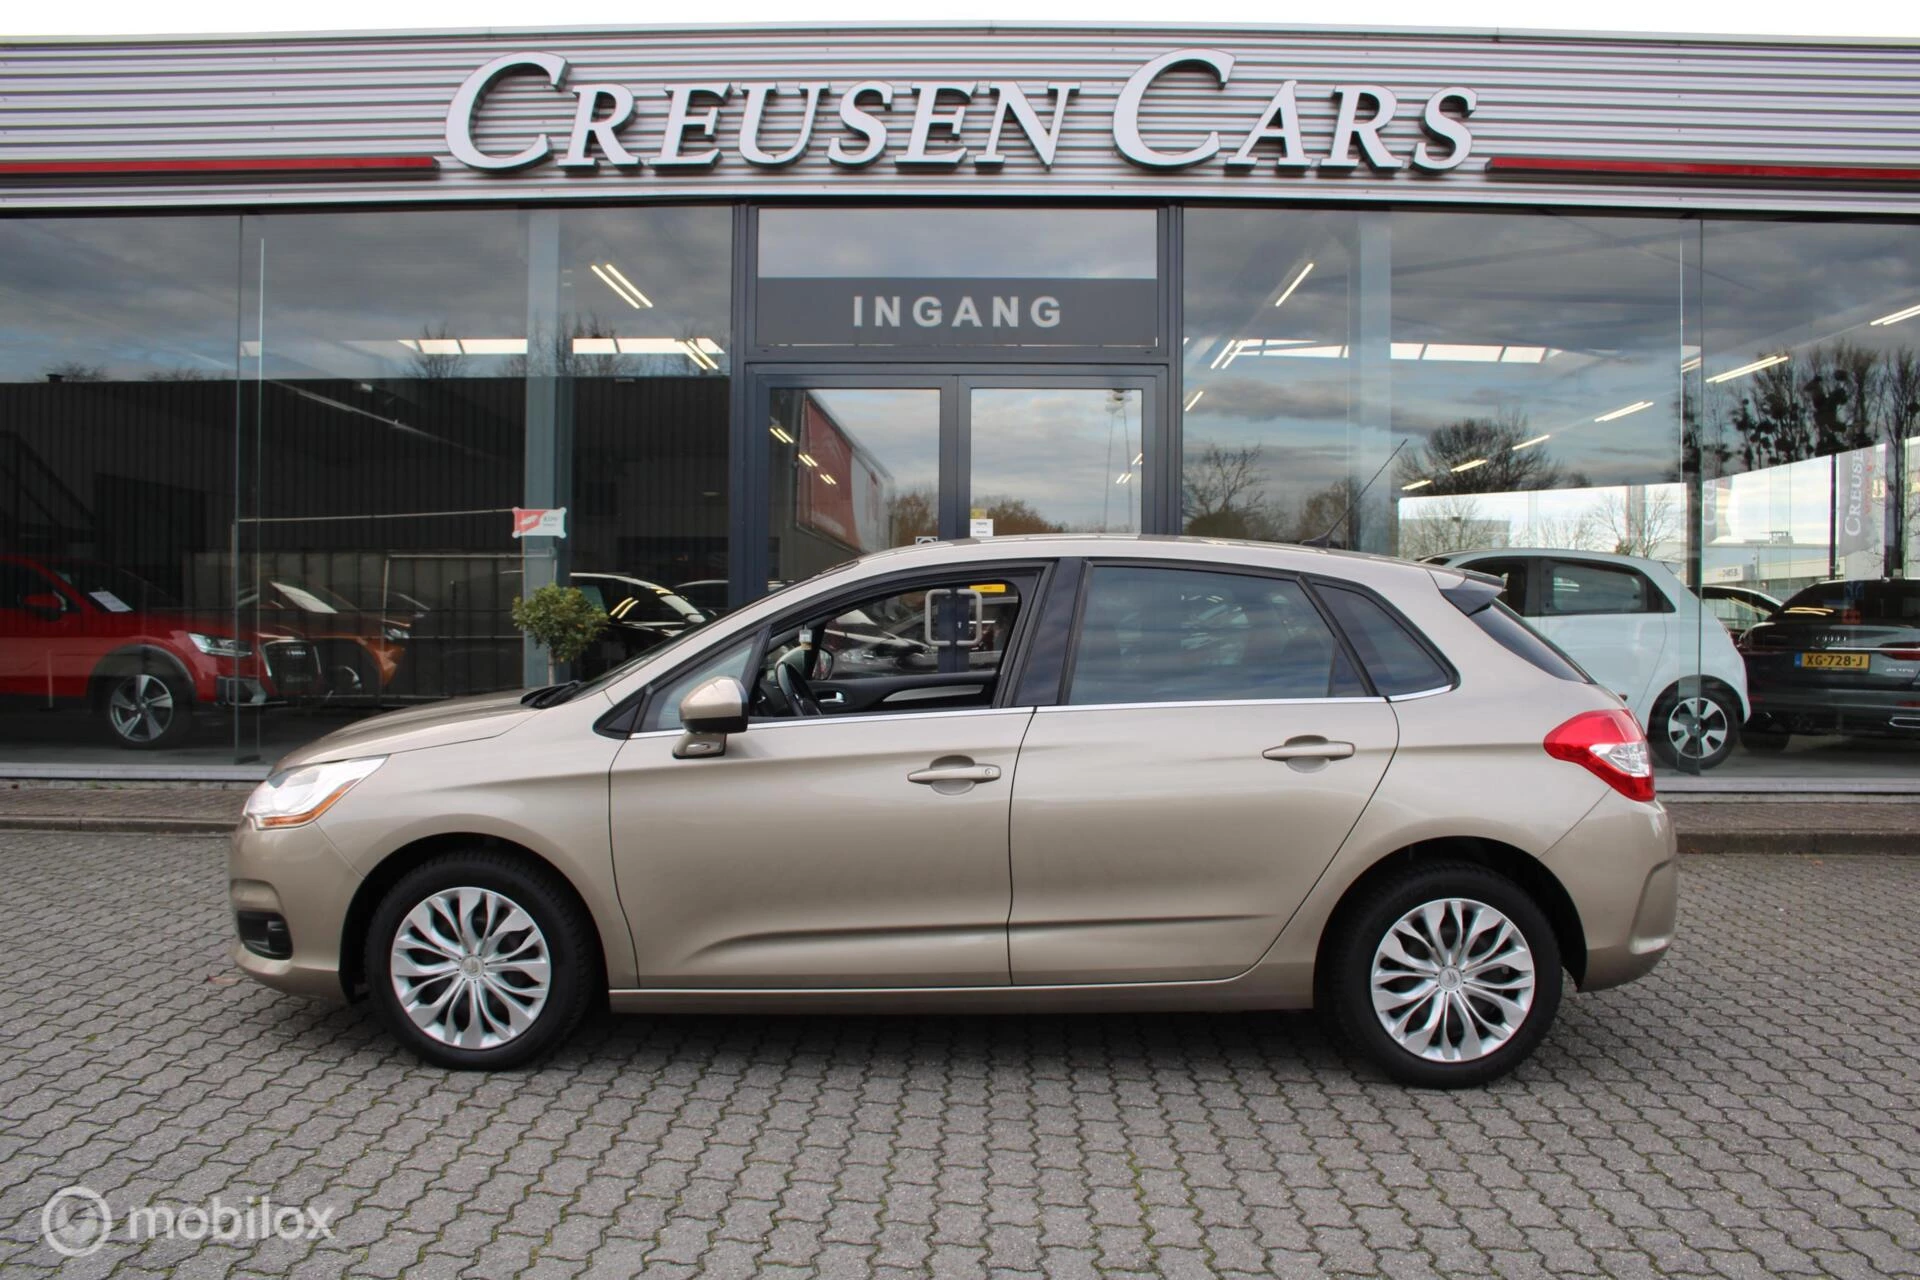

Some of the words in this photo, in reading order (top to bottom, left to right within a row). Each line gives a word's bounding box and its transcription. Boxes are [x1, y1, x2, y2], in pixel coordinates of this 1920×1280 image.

[445, 51, 1081, 172] CREUSEN
[1112, 48, 1478, 173] CARS
[853, 296, 1061, 328] INGANG
[1806, 655, 1863, 666] XG-728-J
